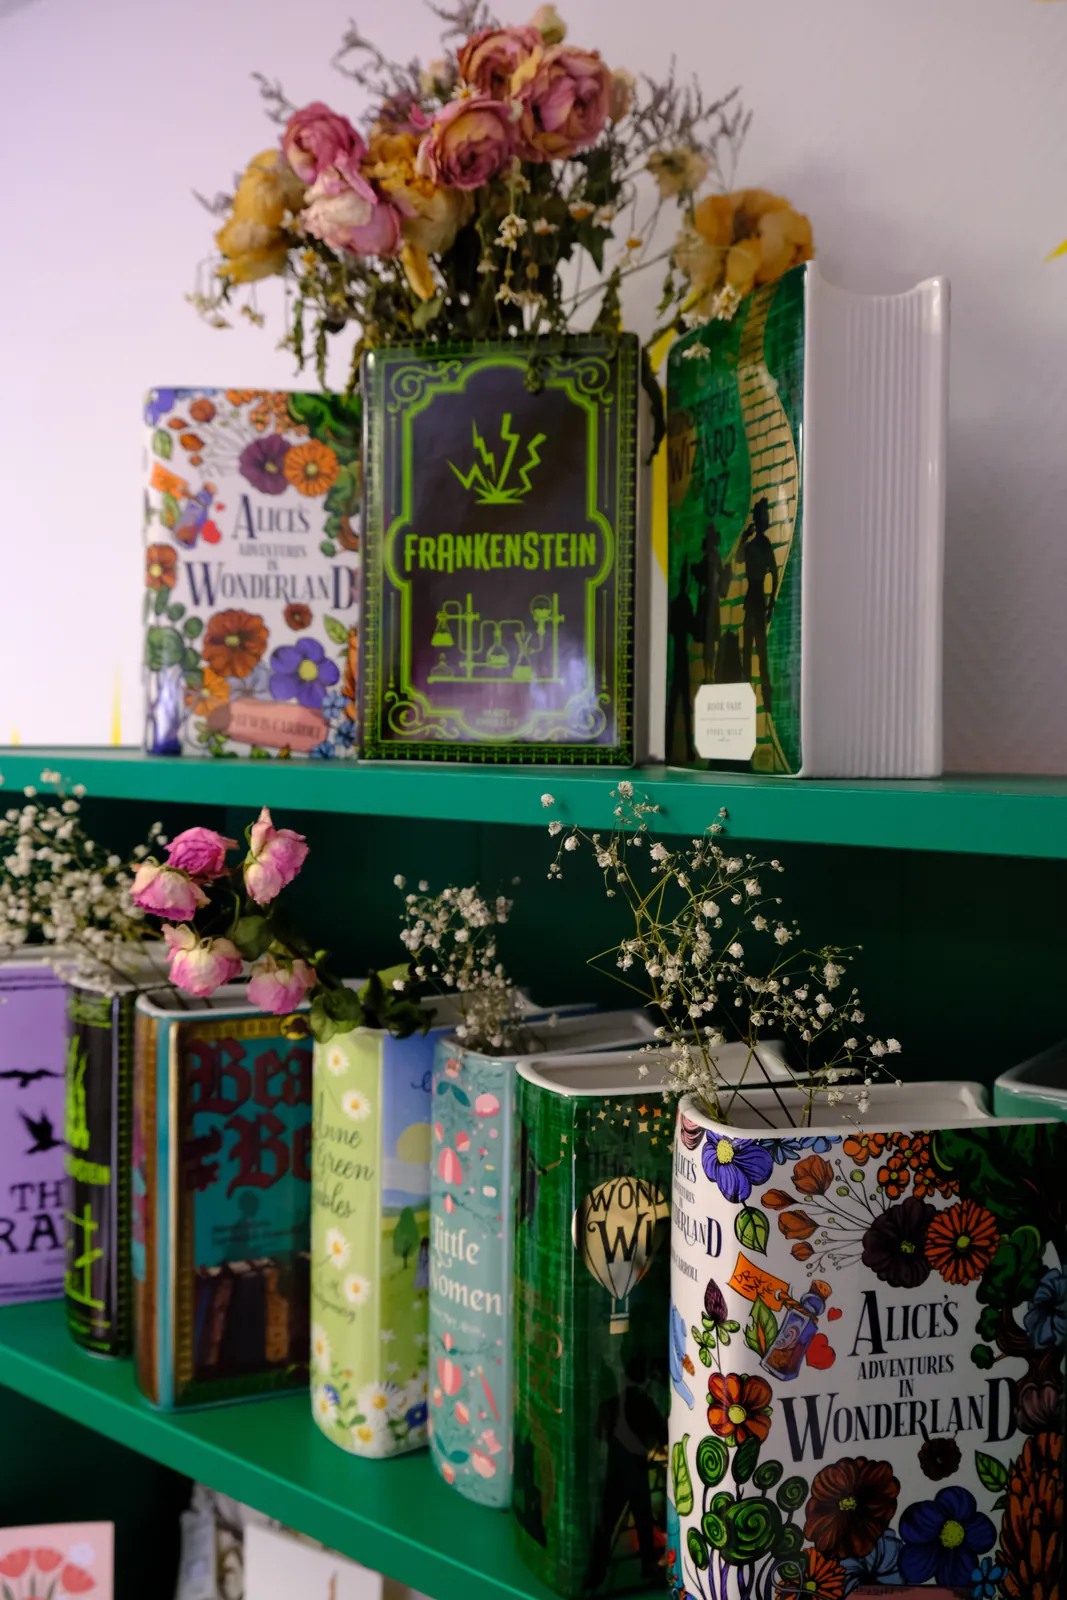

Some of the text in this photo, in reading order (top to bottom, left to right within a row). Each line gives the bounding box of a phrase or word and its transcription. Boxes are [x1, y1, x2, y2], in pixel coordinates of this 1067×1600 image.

[404, 531, 597, 573] FRANKENSTEIN
[184, 561, 356, 610] WONDERLAND
[183, 1036, 313, 1114] Bea
[9, 1180, 64, 1213] TH
[589, 1179, 669, 1213] WOND
[0, 1213, 65, 1254] RA
[587, 1211, 653, 1264] WI
[847, 1290, 960, 1358] ALICE'S
[857, 1354, 955, 1382] ADVENTURES
[898, 1379, 915, 1399] IN
[776, 1376, 1019, 1464] WONDERLAND
